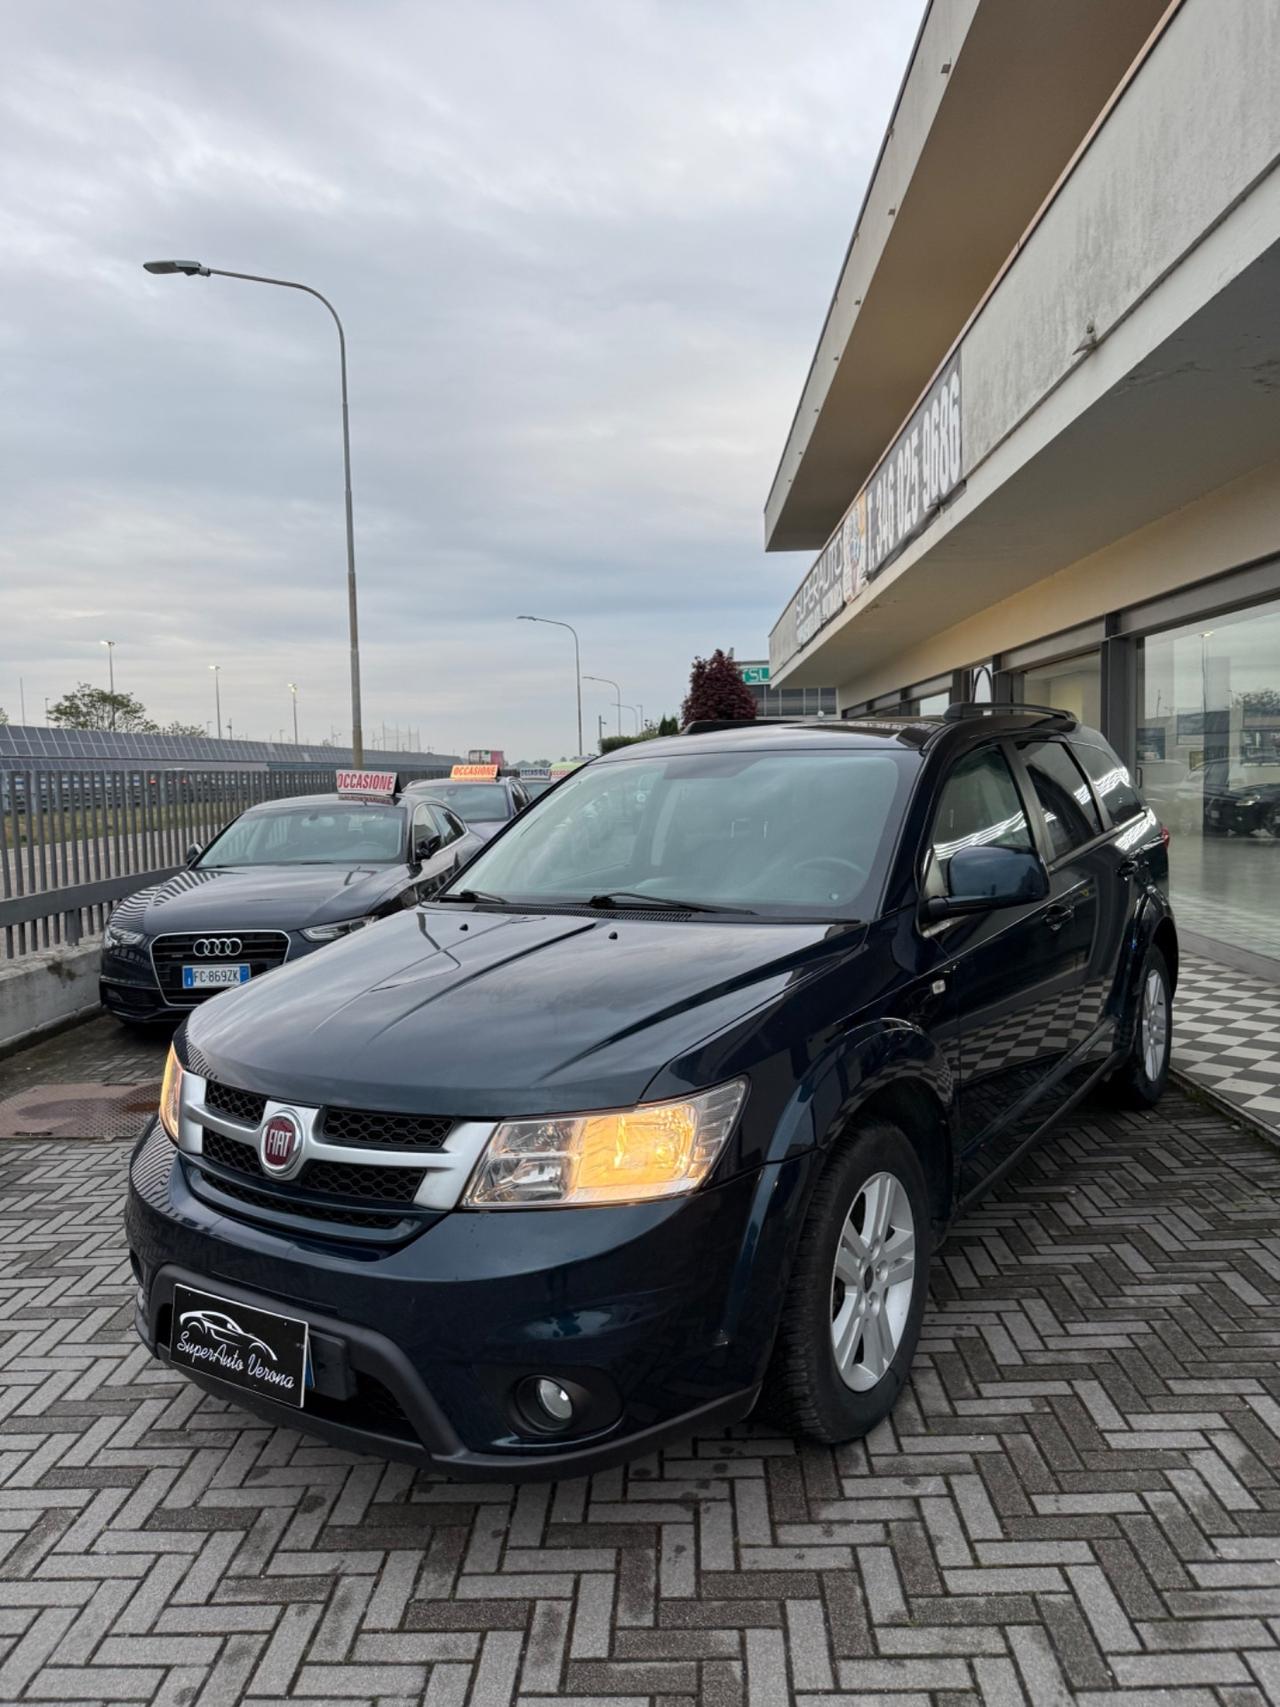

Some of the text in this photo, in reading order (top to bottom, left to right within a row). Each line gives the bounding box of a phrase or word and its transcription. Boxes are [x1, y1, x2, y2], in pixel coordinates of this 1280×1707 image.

[876, 463, 894, 561] 346
[896, 426, 918, 541] 025
[922, 370, 960, 512] 9686
[337, 773, 393, 790] OCCASIONE
[453, 766, 496, 776] OCCASIONE
[267, 1128, 293, 1158] FIAT
[176, 1330, 295, 1389] SuperAuto Verona
